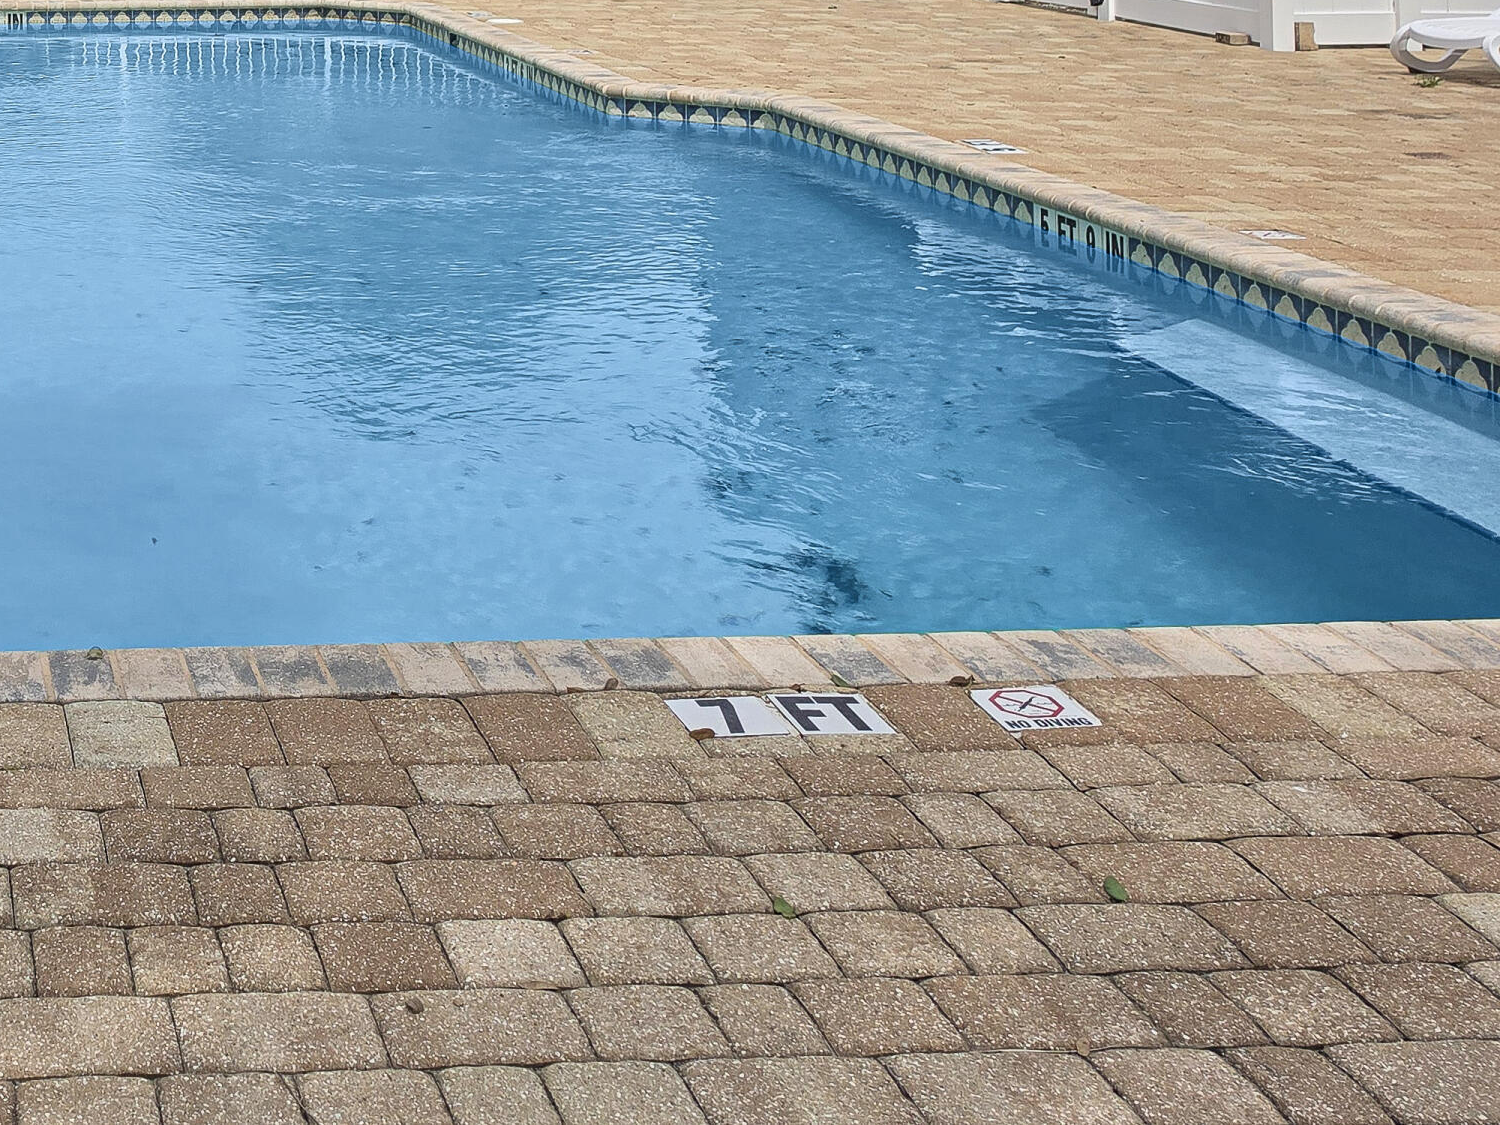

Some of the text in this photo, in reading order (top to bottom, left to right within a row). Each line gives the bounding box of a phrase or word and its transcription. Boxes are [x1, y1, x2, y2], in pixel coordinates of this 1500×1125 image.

[1057, 214, 1077, 241] FT
[1105, 230, 1124, 259] IN
[694, 695, 873, 734] 7 FT
[1005, 717, 1093, 729] NO DIVING
